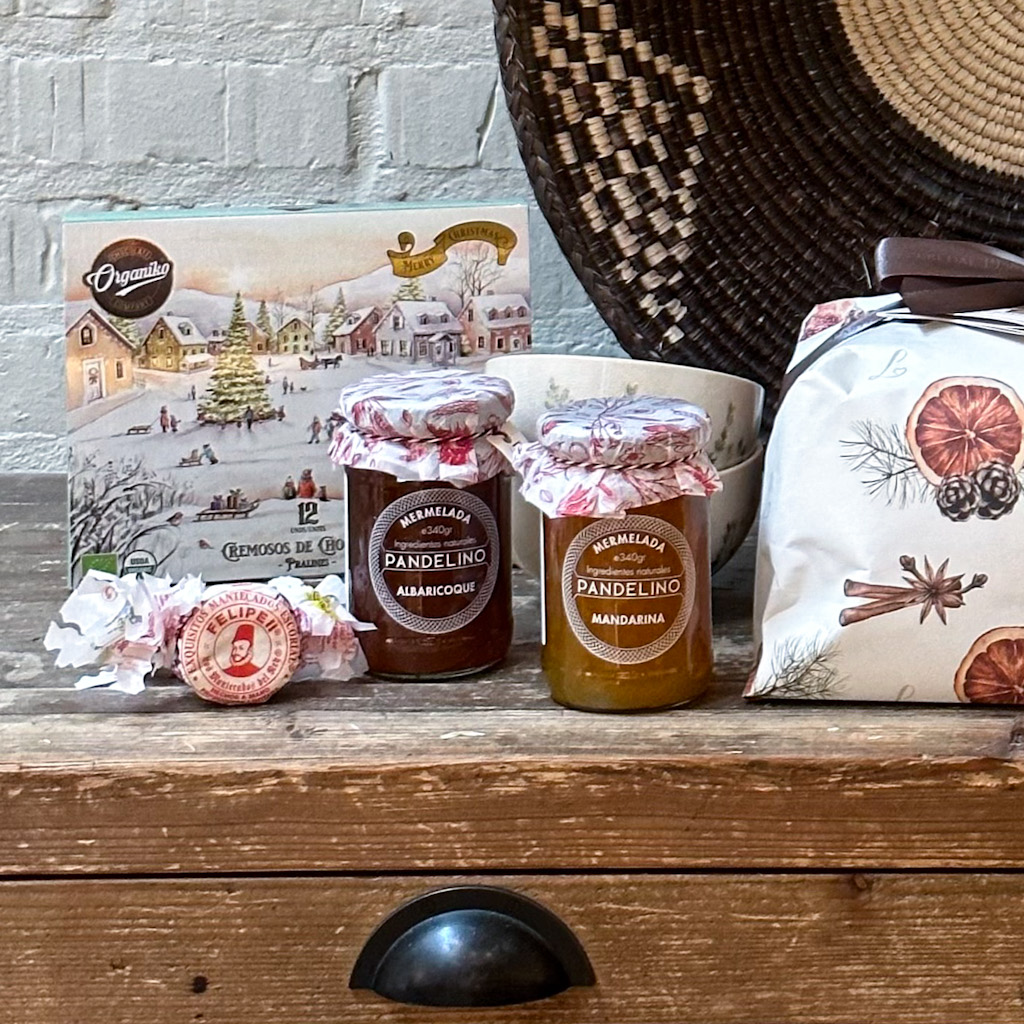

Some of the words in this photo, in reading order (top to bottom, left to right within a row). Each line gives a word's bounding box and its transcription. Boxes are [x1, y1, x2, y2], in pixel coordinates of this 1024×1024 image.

[402, 257, 435, 272] MERRY
[448, 226, 501, 242] CHRISTMAS
[86, 261, 170, 293] Organiko
[297, 501, 319, 525] 12
[400, 506, 472, 529] MERMELADA
[221, 541, 291, 562] CREMOSOS
[296, 540, 313, 553] DE
[592, 533, 666, 555] MERMELADA
[385, 548, 486, 569] PANDELINO
[396, 581, 476, 597] ALBARICOQUE
[577, 579, 681, 596] PANDELINO
[206, 607, 268, 635] FELIPE
[591, 613, 666, 626] MANDARINA
[184, 611, 209, 674] EXQUISITOS
[208, 591, 280, 611] MANTECADOS
[280, 610, 300, 662] ESCORIAL
